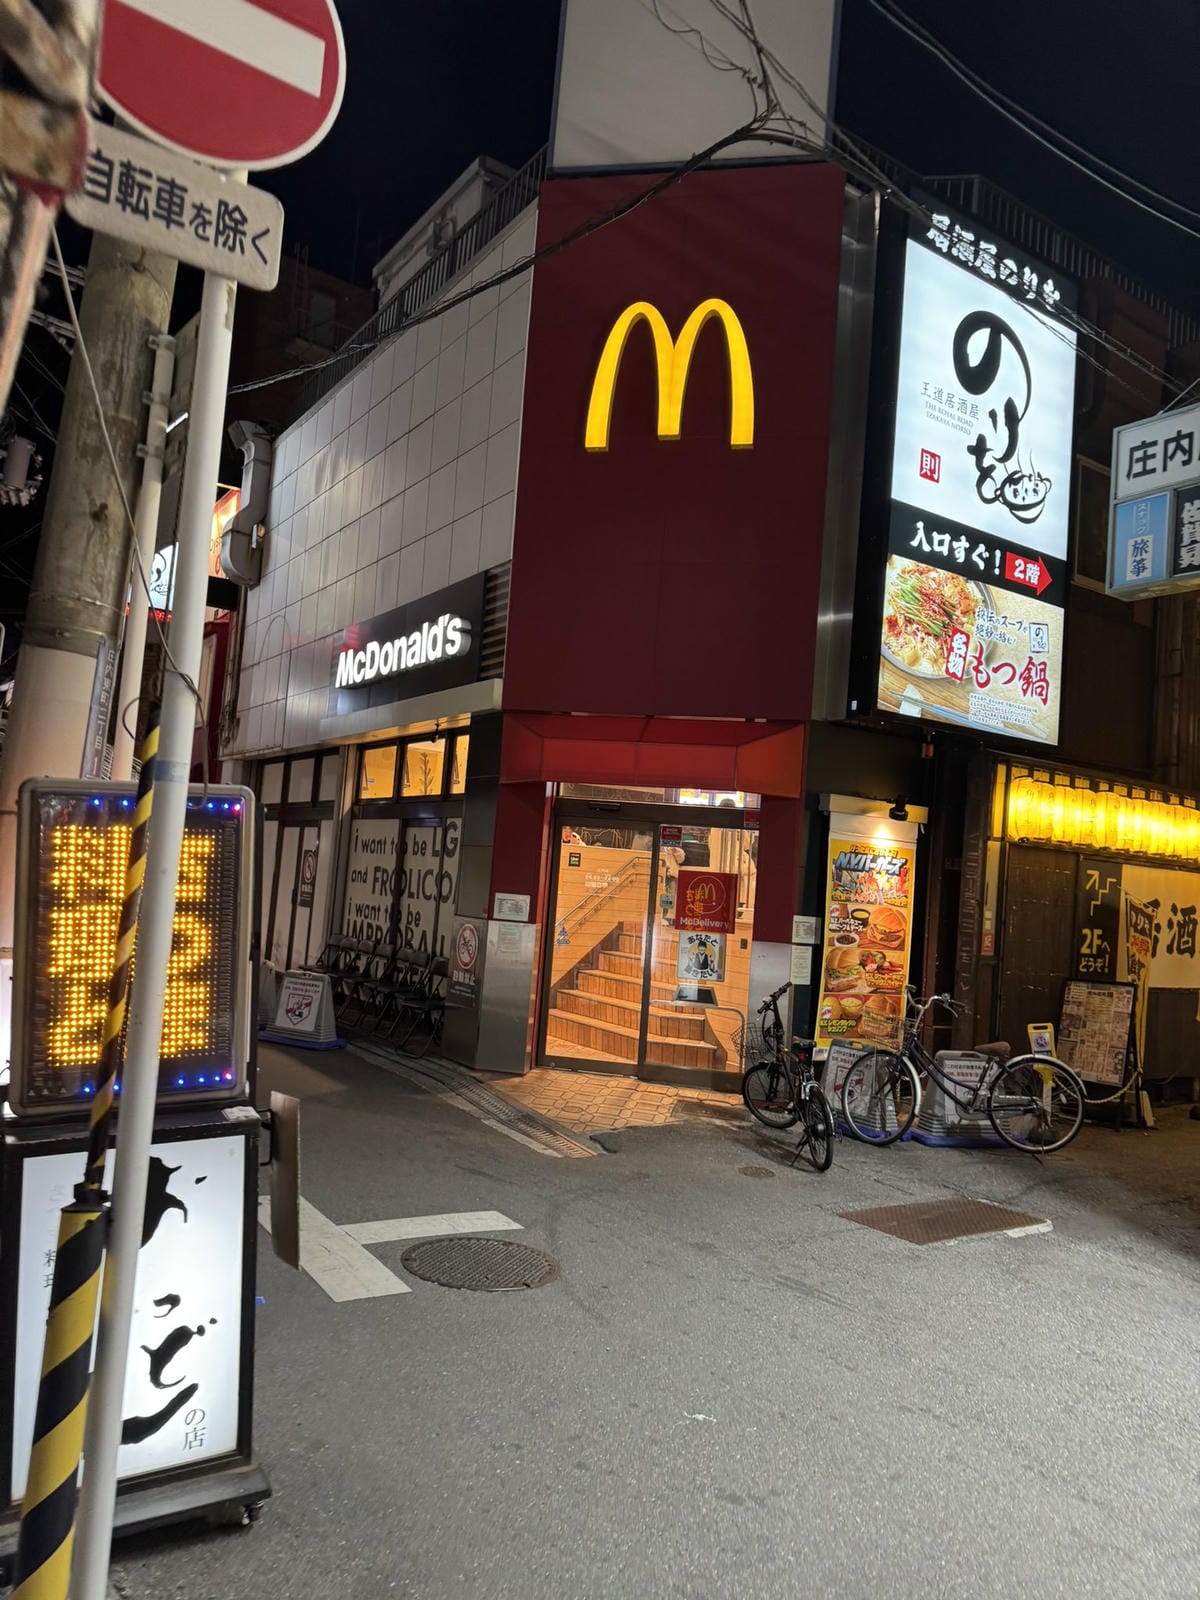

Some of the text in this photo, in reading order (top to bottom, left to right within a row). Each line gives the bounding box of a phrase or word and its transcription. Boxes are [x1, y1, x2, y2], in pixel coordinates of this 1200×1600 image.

[84, 147, 271, 265] 自転車を除く
[920, 382, 980, 420] 王道居酒屋
[1126, 429, 1200, 481] 庄内
[1013, 559, 1041, 585] 2階
[335, 613, 466, 689] McDonald's
[969, 641, 1050, 706] もつ鍋
[354, 829, 360, 853] i
[361, 840, 388, 855] want
[412, 835, 427, 857] be
[351, 868, 368, 884] and
[355, 902, 381, 921] want
[406, 904, 421, 927] be
[680, 916, 730, 929] McDelivery
[687, 933, 719, 947] あなたと
[1079, 954, 1109, 974] どうぞ!
[183, 1407, 206, 1452] の店
